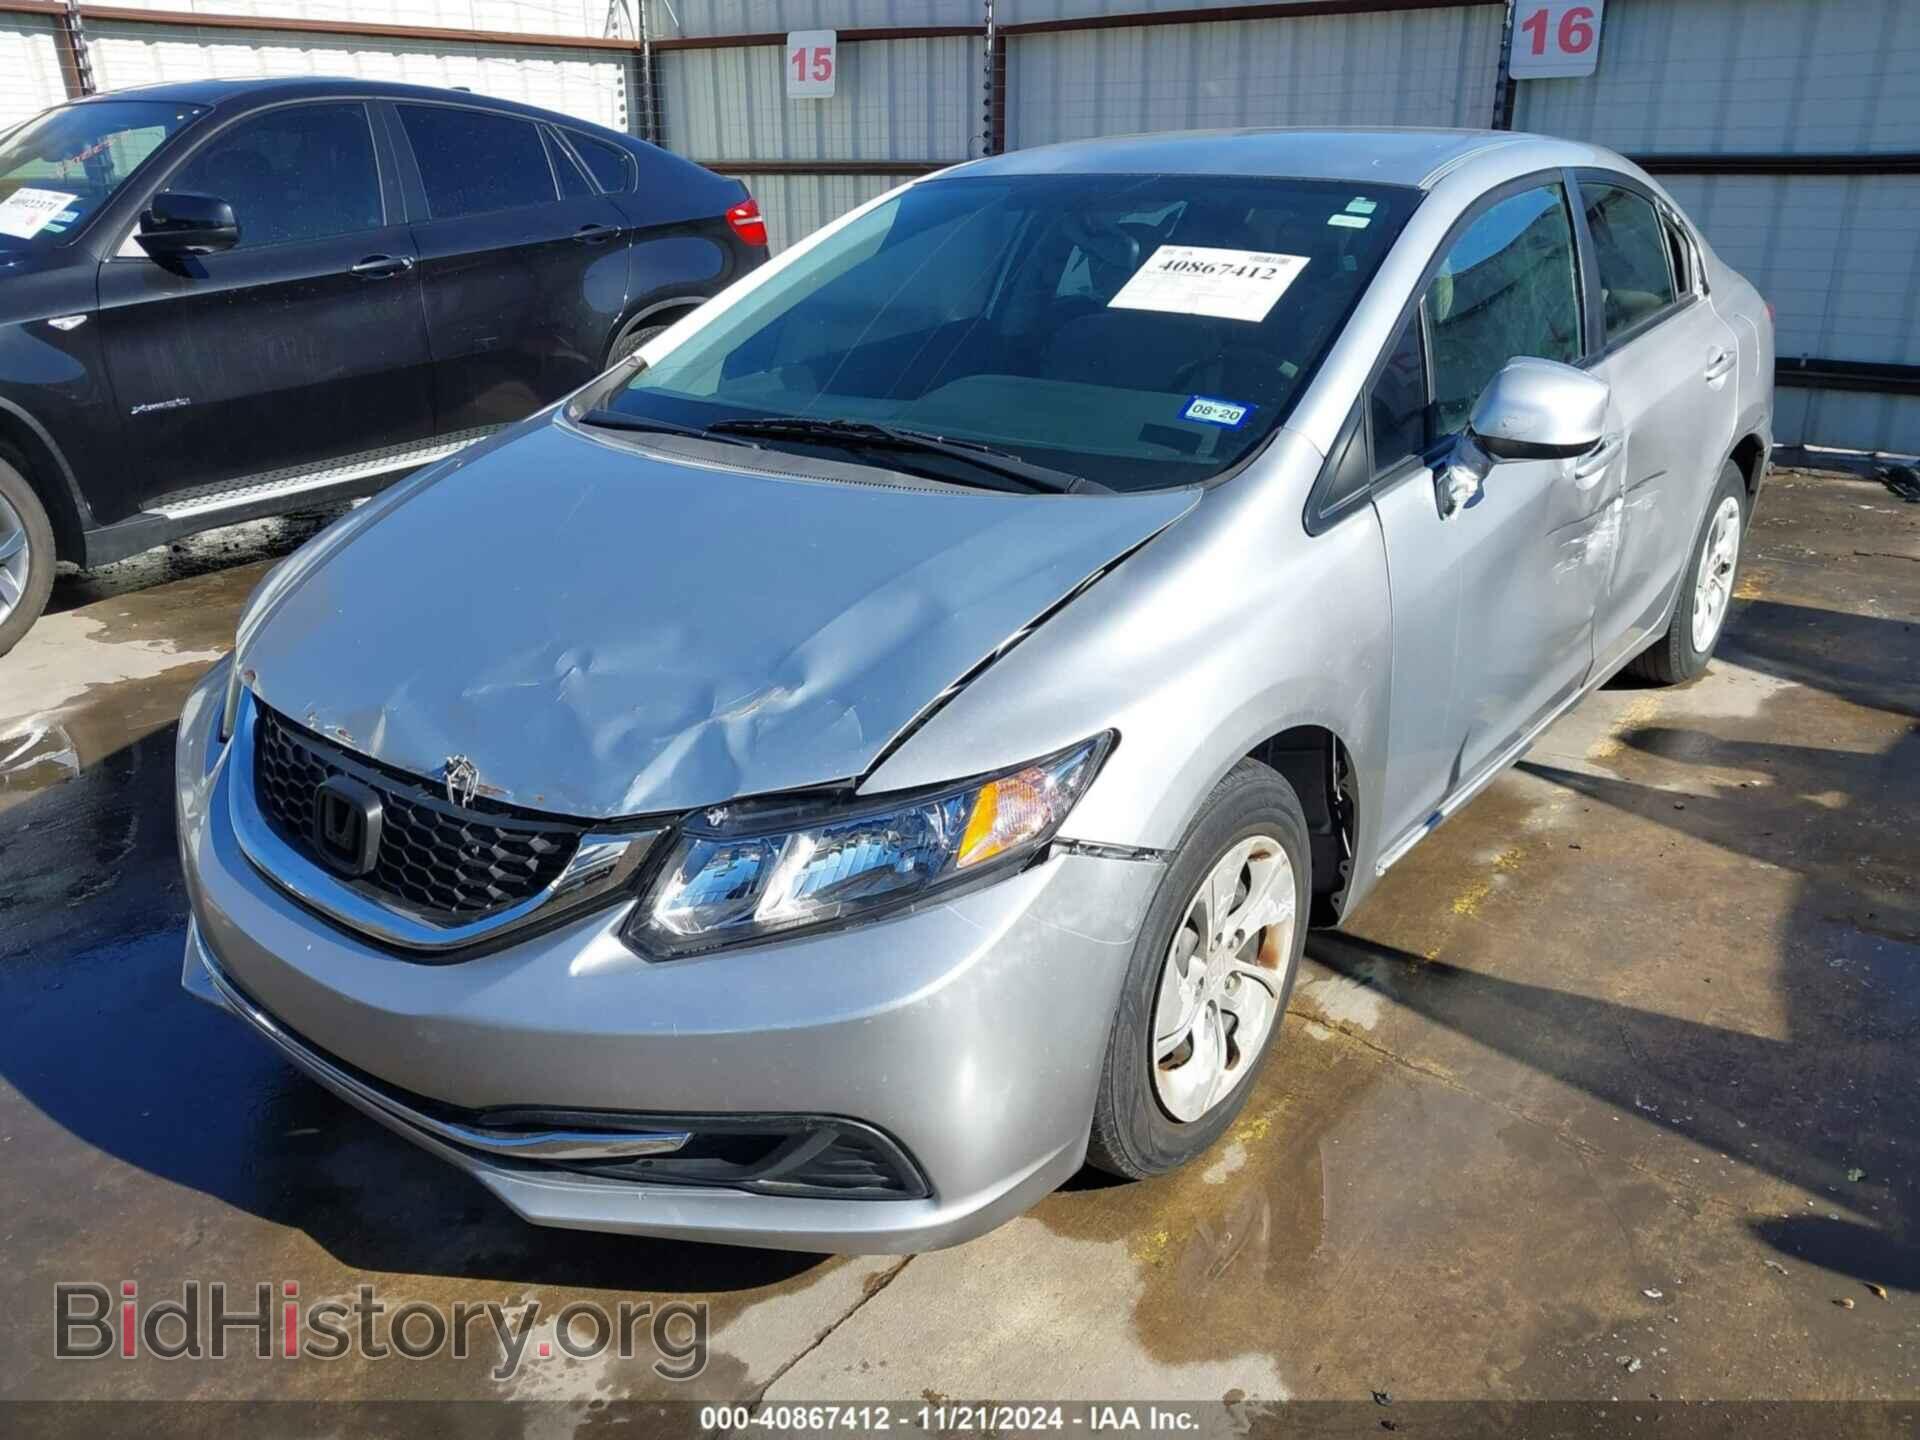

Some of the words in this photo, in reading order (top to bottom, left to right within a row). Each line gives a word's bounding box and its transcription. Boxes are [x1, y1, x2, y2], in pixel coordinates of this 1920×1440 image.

[1522, 6, 1594, 55] 16
[791, 47, 833, 82] 15
[1158, 259, 1278, 281] 40867412
